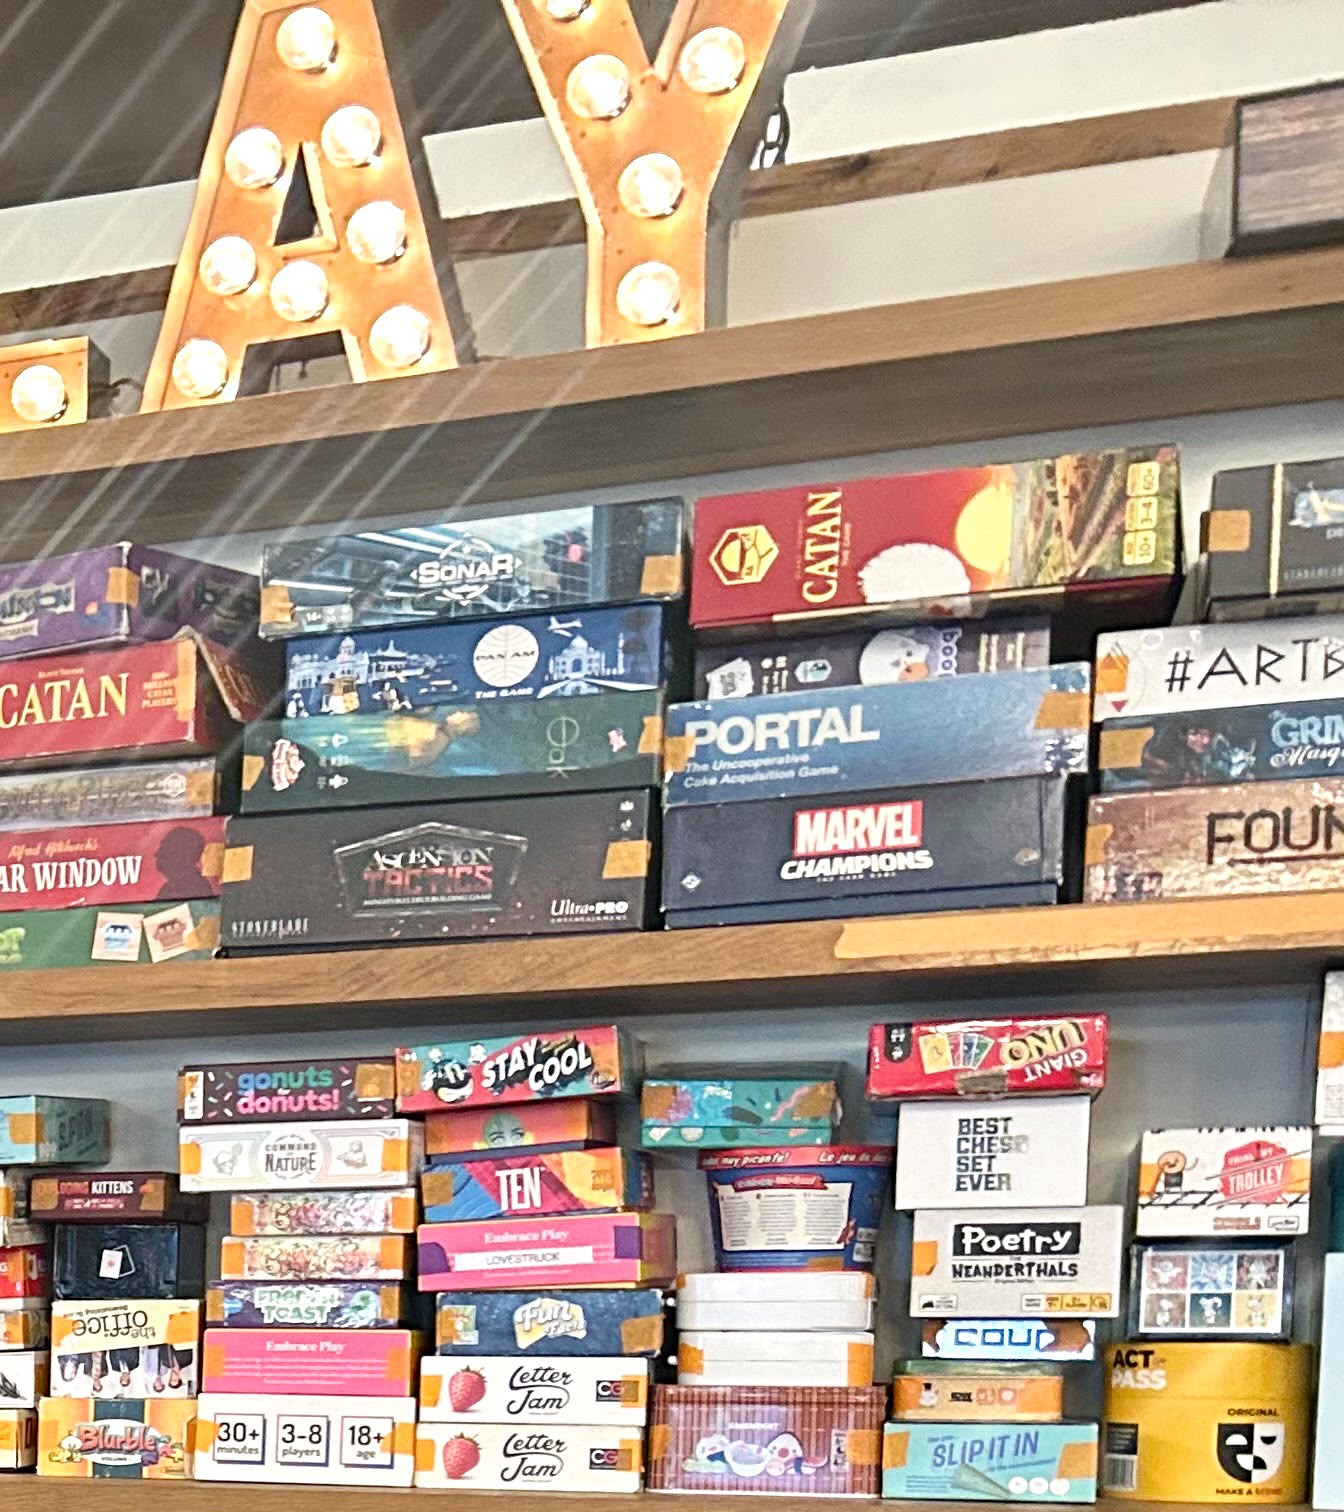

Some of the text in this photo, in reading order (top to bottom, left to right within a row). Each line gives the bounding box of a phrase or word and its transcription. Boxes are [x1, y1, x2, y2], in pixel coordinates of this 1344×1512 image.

[802, 490, 843, 603] CATAN
[418, 553, 516, 585] SONAR
[684, 703, 881, 758] PORTAL
[796, 804, 919, 855] MARVEL
[32, 855, 143, 889] WINDOW
[780, 849, 934, 880] CHAMPIONS
[363, 865, 494, 896] TACTICS
[481, 1037, 542, 1090] STAY
[528, 1041, 595, 1092] COOL
[957, 1117, 1013, 1136] BEST
[264, 1151, 318, 1173] NATURE
[955, 1155, 997, 1173] SET
[91, 1180, 134, 1196] KITTENS
[495, 1167, 541, 1211] TEN
[955, 1173, 1012, 1193] EVER
[1228, 1166, 1284, 1194] TROLLEY
[483, 1228, 569, 1244] Embrace Play
[961, 1225, 1073, 1253] Poetry
[486, 1251, 561, 1265] LOVESTRUCK
[951, 1260, 1079, 1281] NEANDERTHALS
[1112, 1349, 1155, 1370] ACT
[508, 1365, 575, 1392] Letter
[1111, 1370, 1167, 1390] PASS
[506, 1384, 571, 1415] Jam
[1226, 1407, 1280, 1417] ORIGINAL
[79, 1424, 156, 1452] Blurble
[217, 1422, 260, 1442] 30+
[281, 1422, 323, 1443] 3-8
[348, 1426, 384, 1446] 18+
[217, 1445, 259, 1455] minutes
[281, 1445, 322, 1458] players
[356, 1449, 376, 1460] age
[502, 1434, 567, 1459] Letter
[931, 1431, 1039, 1470] SLIP IT IN
[500, 1451, 564, 1482] Jam
